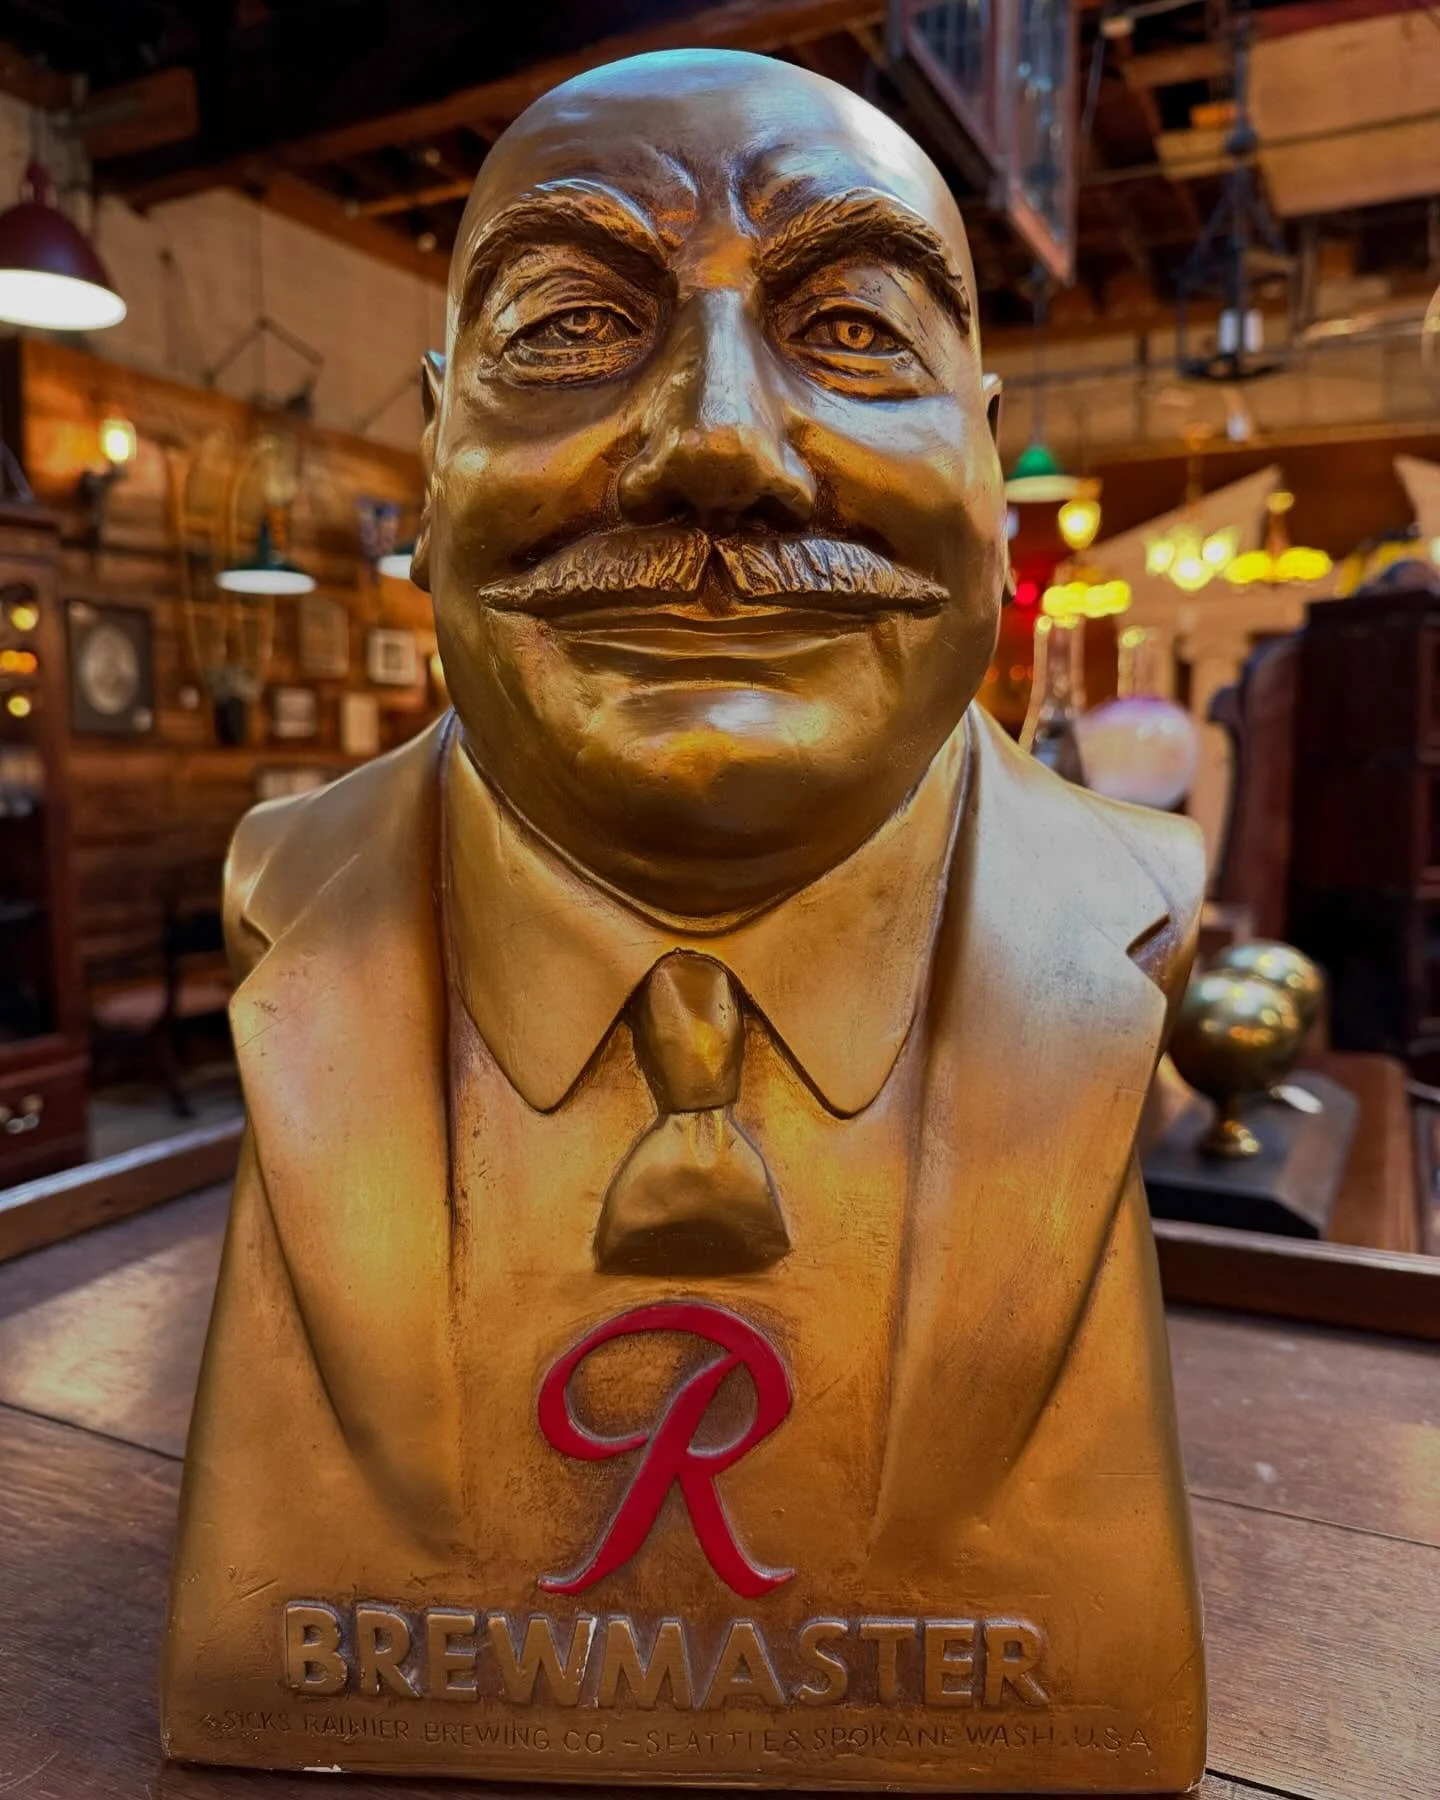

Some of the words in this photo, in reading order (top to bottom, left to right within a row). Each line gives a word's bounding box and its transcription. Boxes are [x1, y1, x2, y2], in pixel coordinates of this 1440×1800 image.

[536, 1300, 795, 1598] R
[284, 1601, 1050, 1708] BREWMASTER
[303, 1714, 410, 1740] RAINIER
[424, 1722, 550, 1751] BREWING
[564, 1729, 614, 1755] CO.
[813, 1726, 957, 1751] SPOKANE
